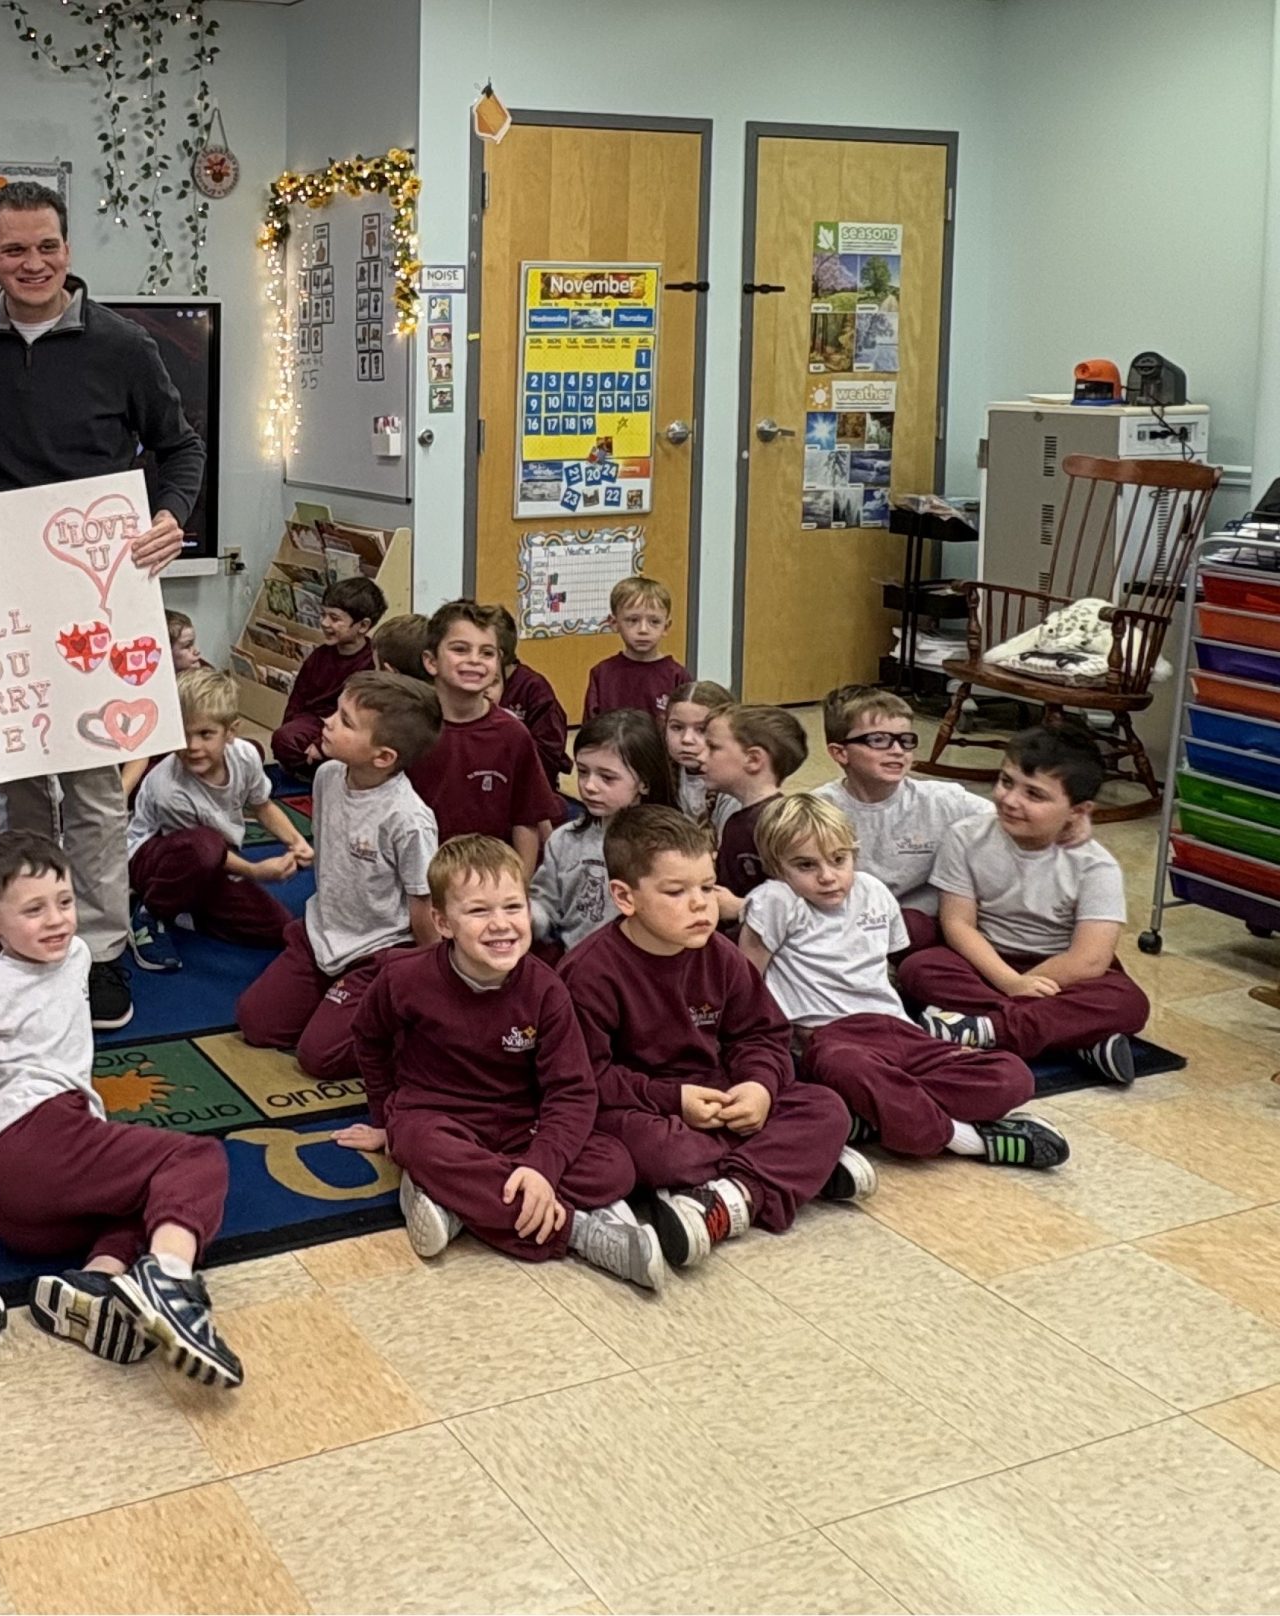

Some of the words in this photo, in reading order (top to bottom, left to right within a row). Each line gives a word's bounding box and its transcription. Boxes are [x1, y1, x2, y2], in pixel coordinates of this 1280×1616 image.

[841, 227, 897, 240] seasons
[427, 270, 459, 281] NOISE
[550, 276, 636, 294] November
[641, 352, 646, 364] 1
[530, 375, 539, 387] 2
[549, 375, 557, 387] 3
[568, 375, 576, 387] 4
[586, 375, 594, 387] 5
[604, 376, 612, 389] 6
[621, 375, 629, 387] 7
[639, 375, 647, 386] 8
[835, 384, 892, 401] weather
[530, 399, 538, 411] 9
[548, 397, 559, 408] 10
[567, 396, 576, 407] 11
[583, 396, 594, 408] 12
[601, 396, 613, 408] 13
[619, 396, 630, 408] 14
[636, 395, 648, 407] 15
[527, 418, 538, 430] 16
[547, 419, 558, 431] 17
[565, 418, 576, 430] 18
[582, 418, 594, 430] 19
[587, 470, 601, 481] 20
[602, 464, 617, 474] 24
[563, 491, 578, 506] 23
[606, 490, 619, 501] 22
[86, 544, 111, 572] U
[93, 1051, 148, 1070] ora
[266, 1079, 368, 1109] ngulo
